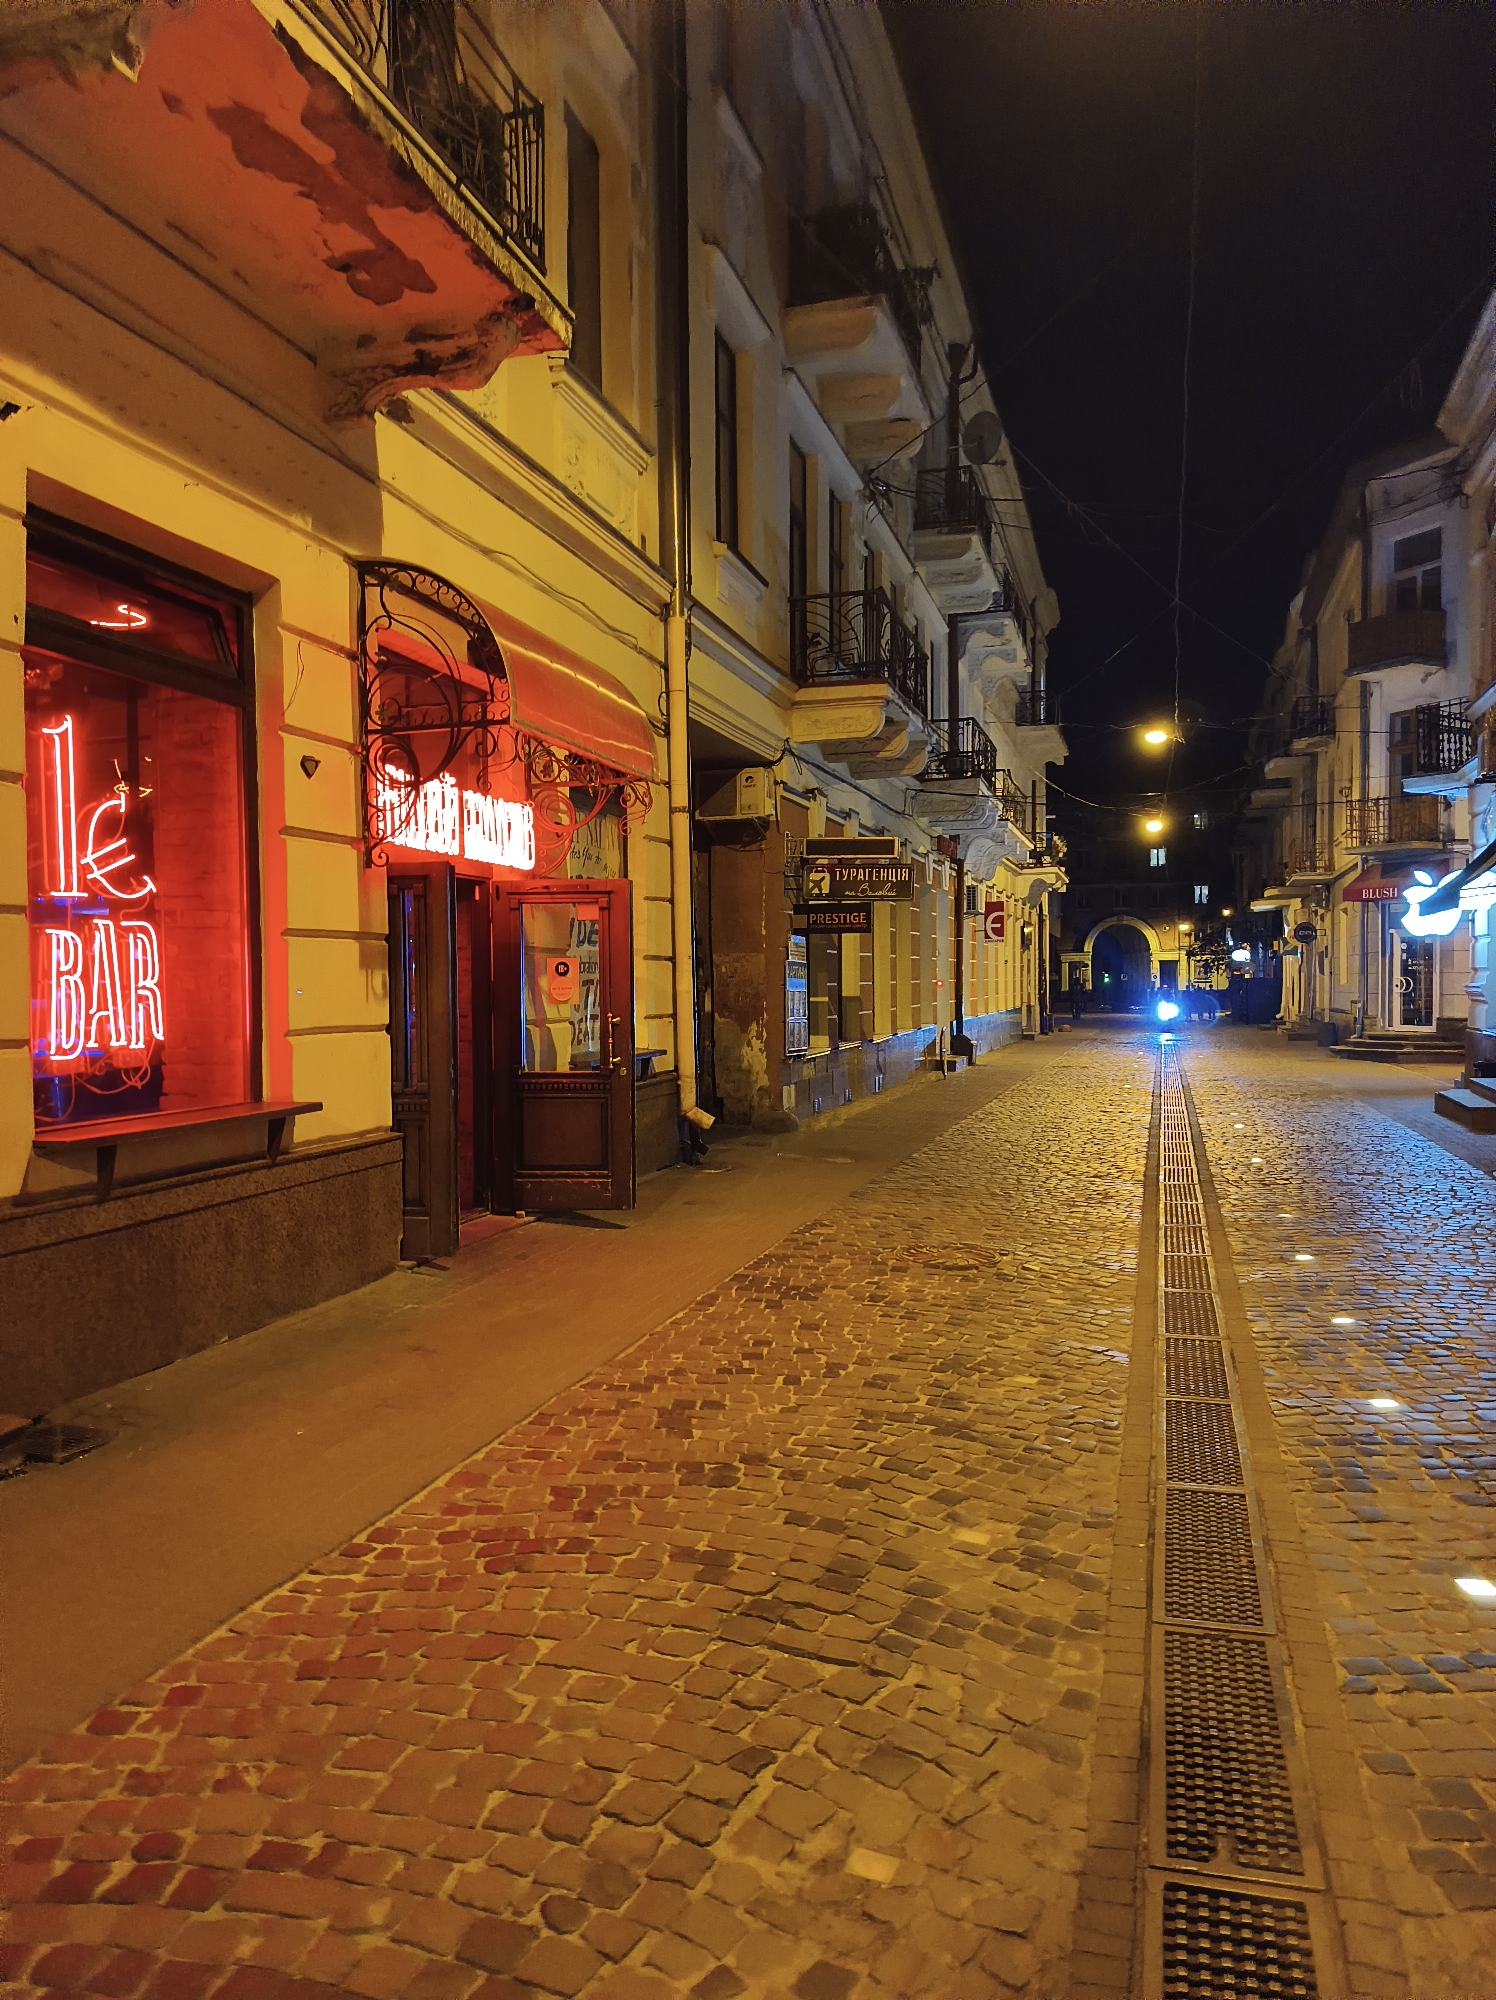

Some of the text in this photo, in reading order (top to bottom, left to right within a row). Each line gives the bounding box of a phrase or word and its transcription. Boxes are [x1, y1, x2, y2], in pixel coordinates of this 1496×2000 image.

[834, 868, 909, 882] ТУРАГЕНЦІЯ
[1362, 887, 1398, 899] BLUSH
[809, 912, 867, 924] PRESTIGE
[558, 964, 568, 973] 18+
[45, 919, 165, 1061] BAR
